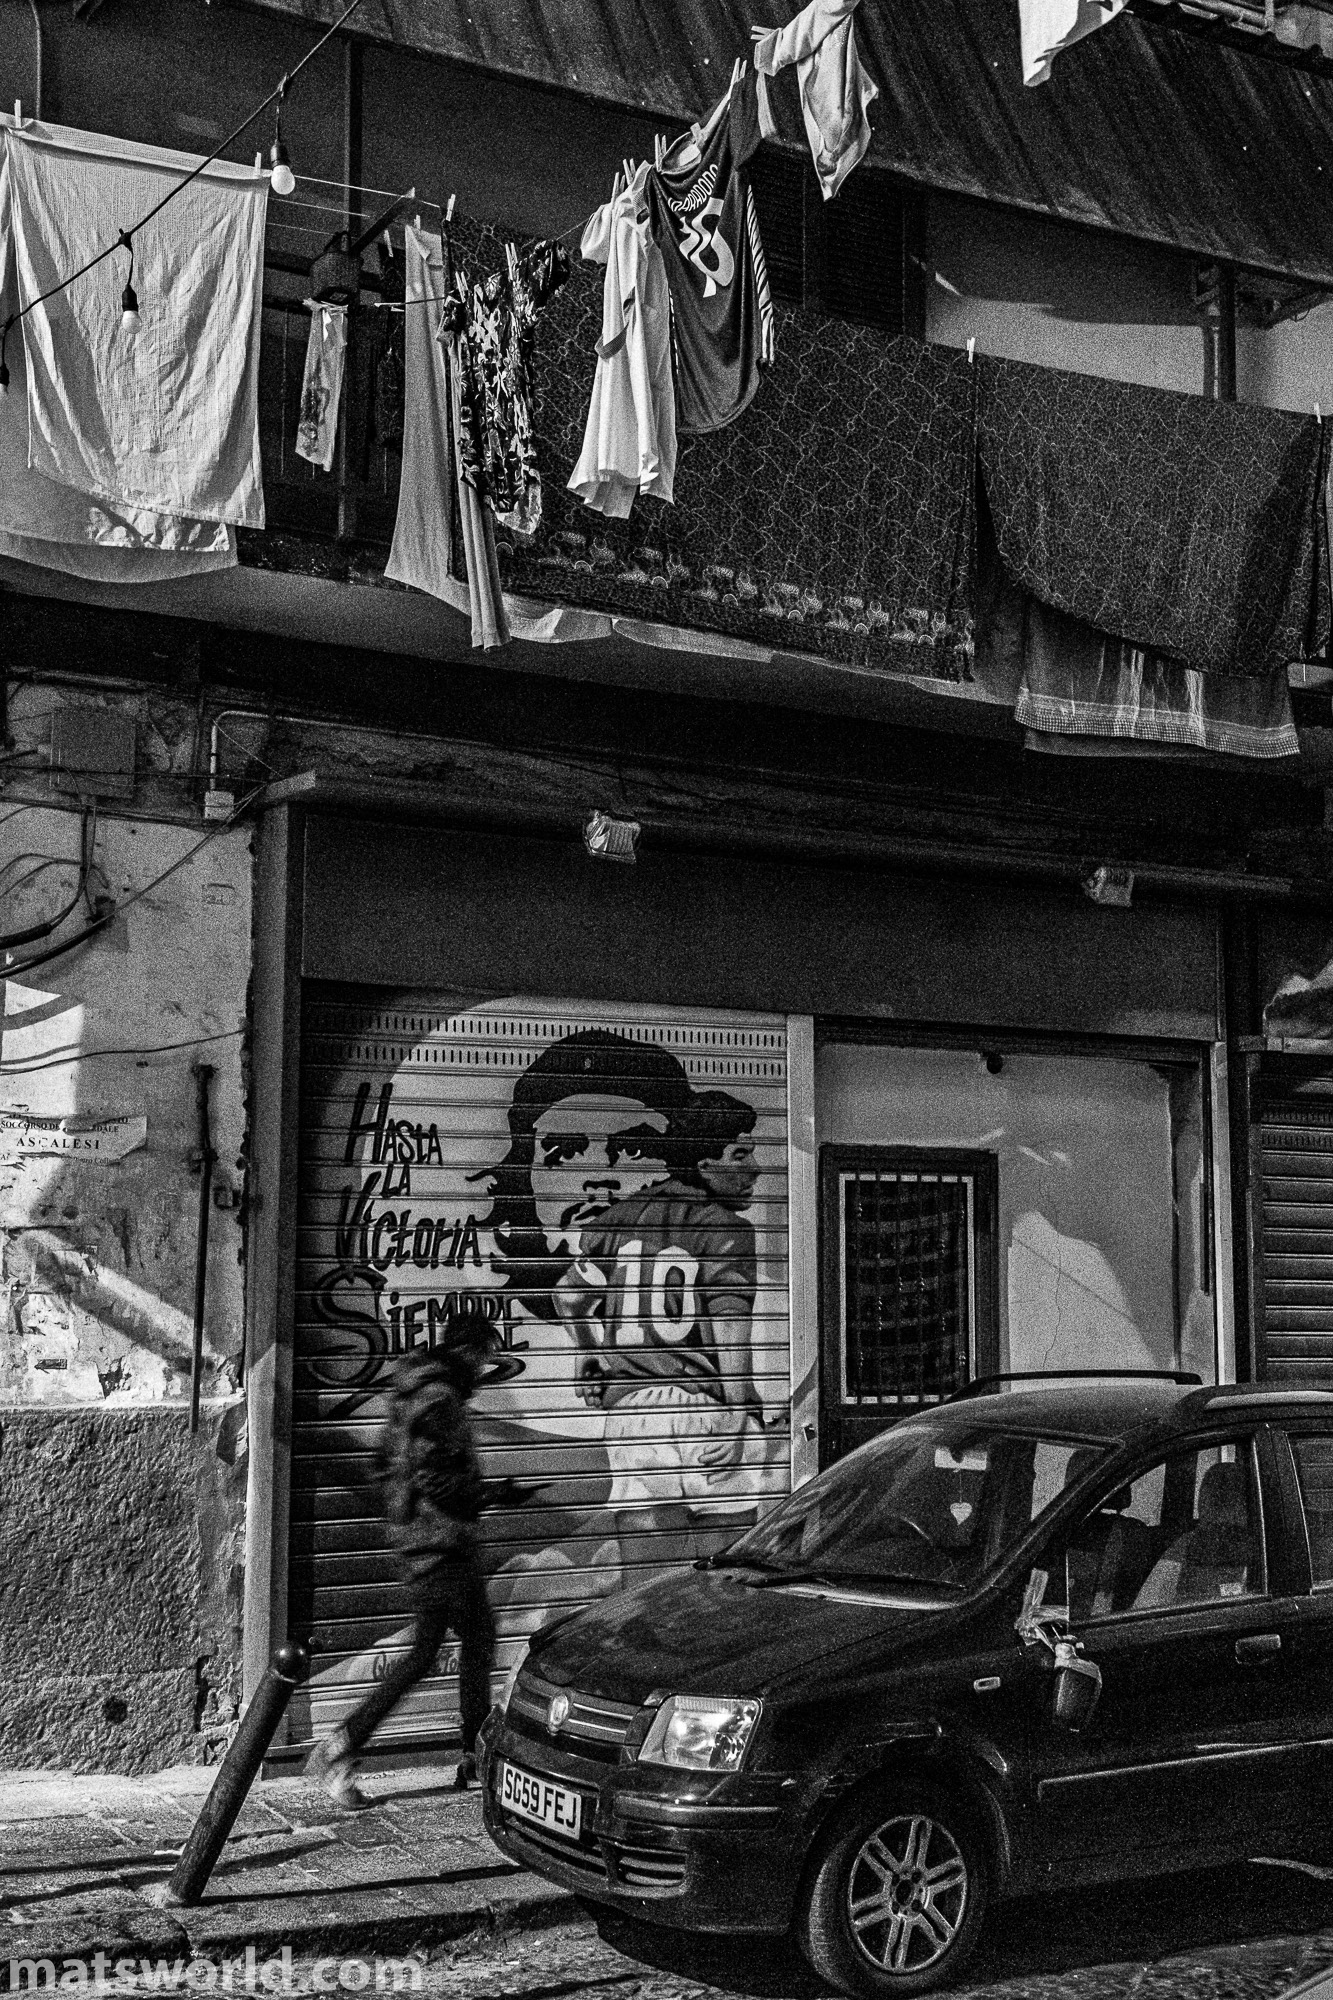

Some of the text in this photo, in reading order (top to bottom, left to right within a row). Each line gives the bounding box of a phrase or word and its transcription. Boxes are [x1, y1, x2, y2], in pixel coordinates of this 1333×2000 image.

[16, 1136, 100, 1150] ASCALESI
[380, 1161, 412, 1198] LA
[614, 1239, 700, 1346] 10
[543, 1786, 577, 1829] FEJ
